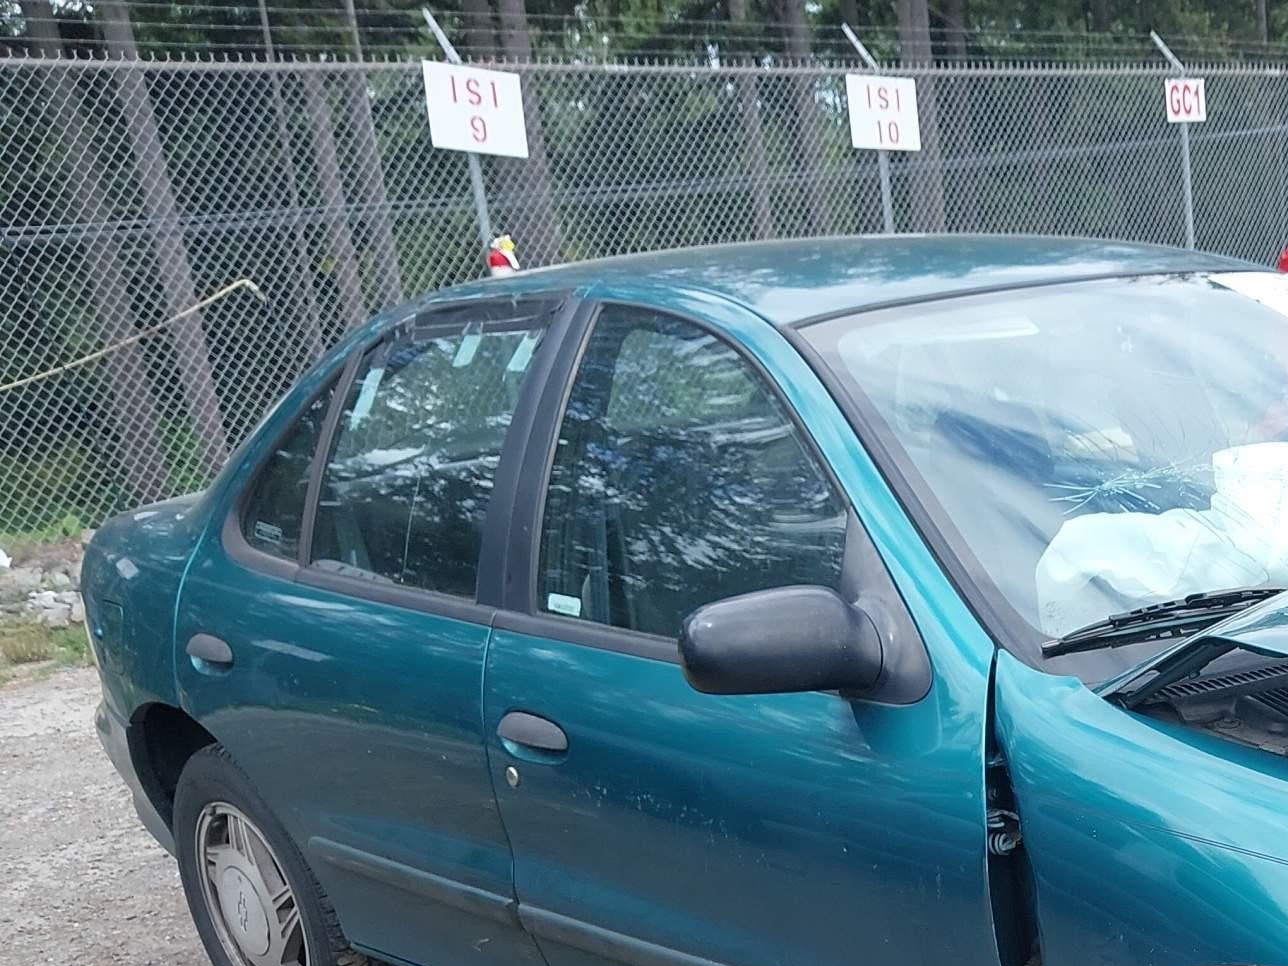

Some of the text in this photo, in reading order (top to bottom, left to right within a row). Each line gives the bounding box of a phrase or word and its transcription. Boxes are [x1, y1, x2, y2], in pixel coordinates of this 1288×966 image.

[1170, 84, 1201, 115] GC1
[470, 115, 488, 143] 9
[877, 119, 899, 145] 10
